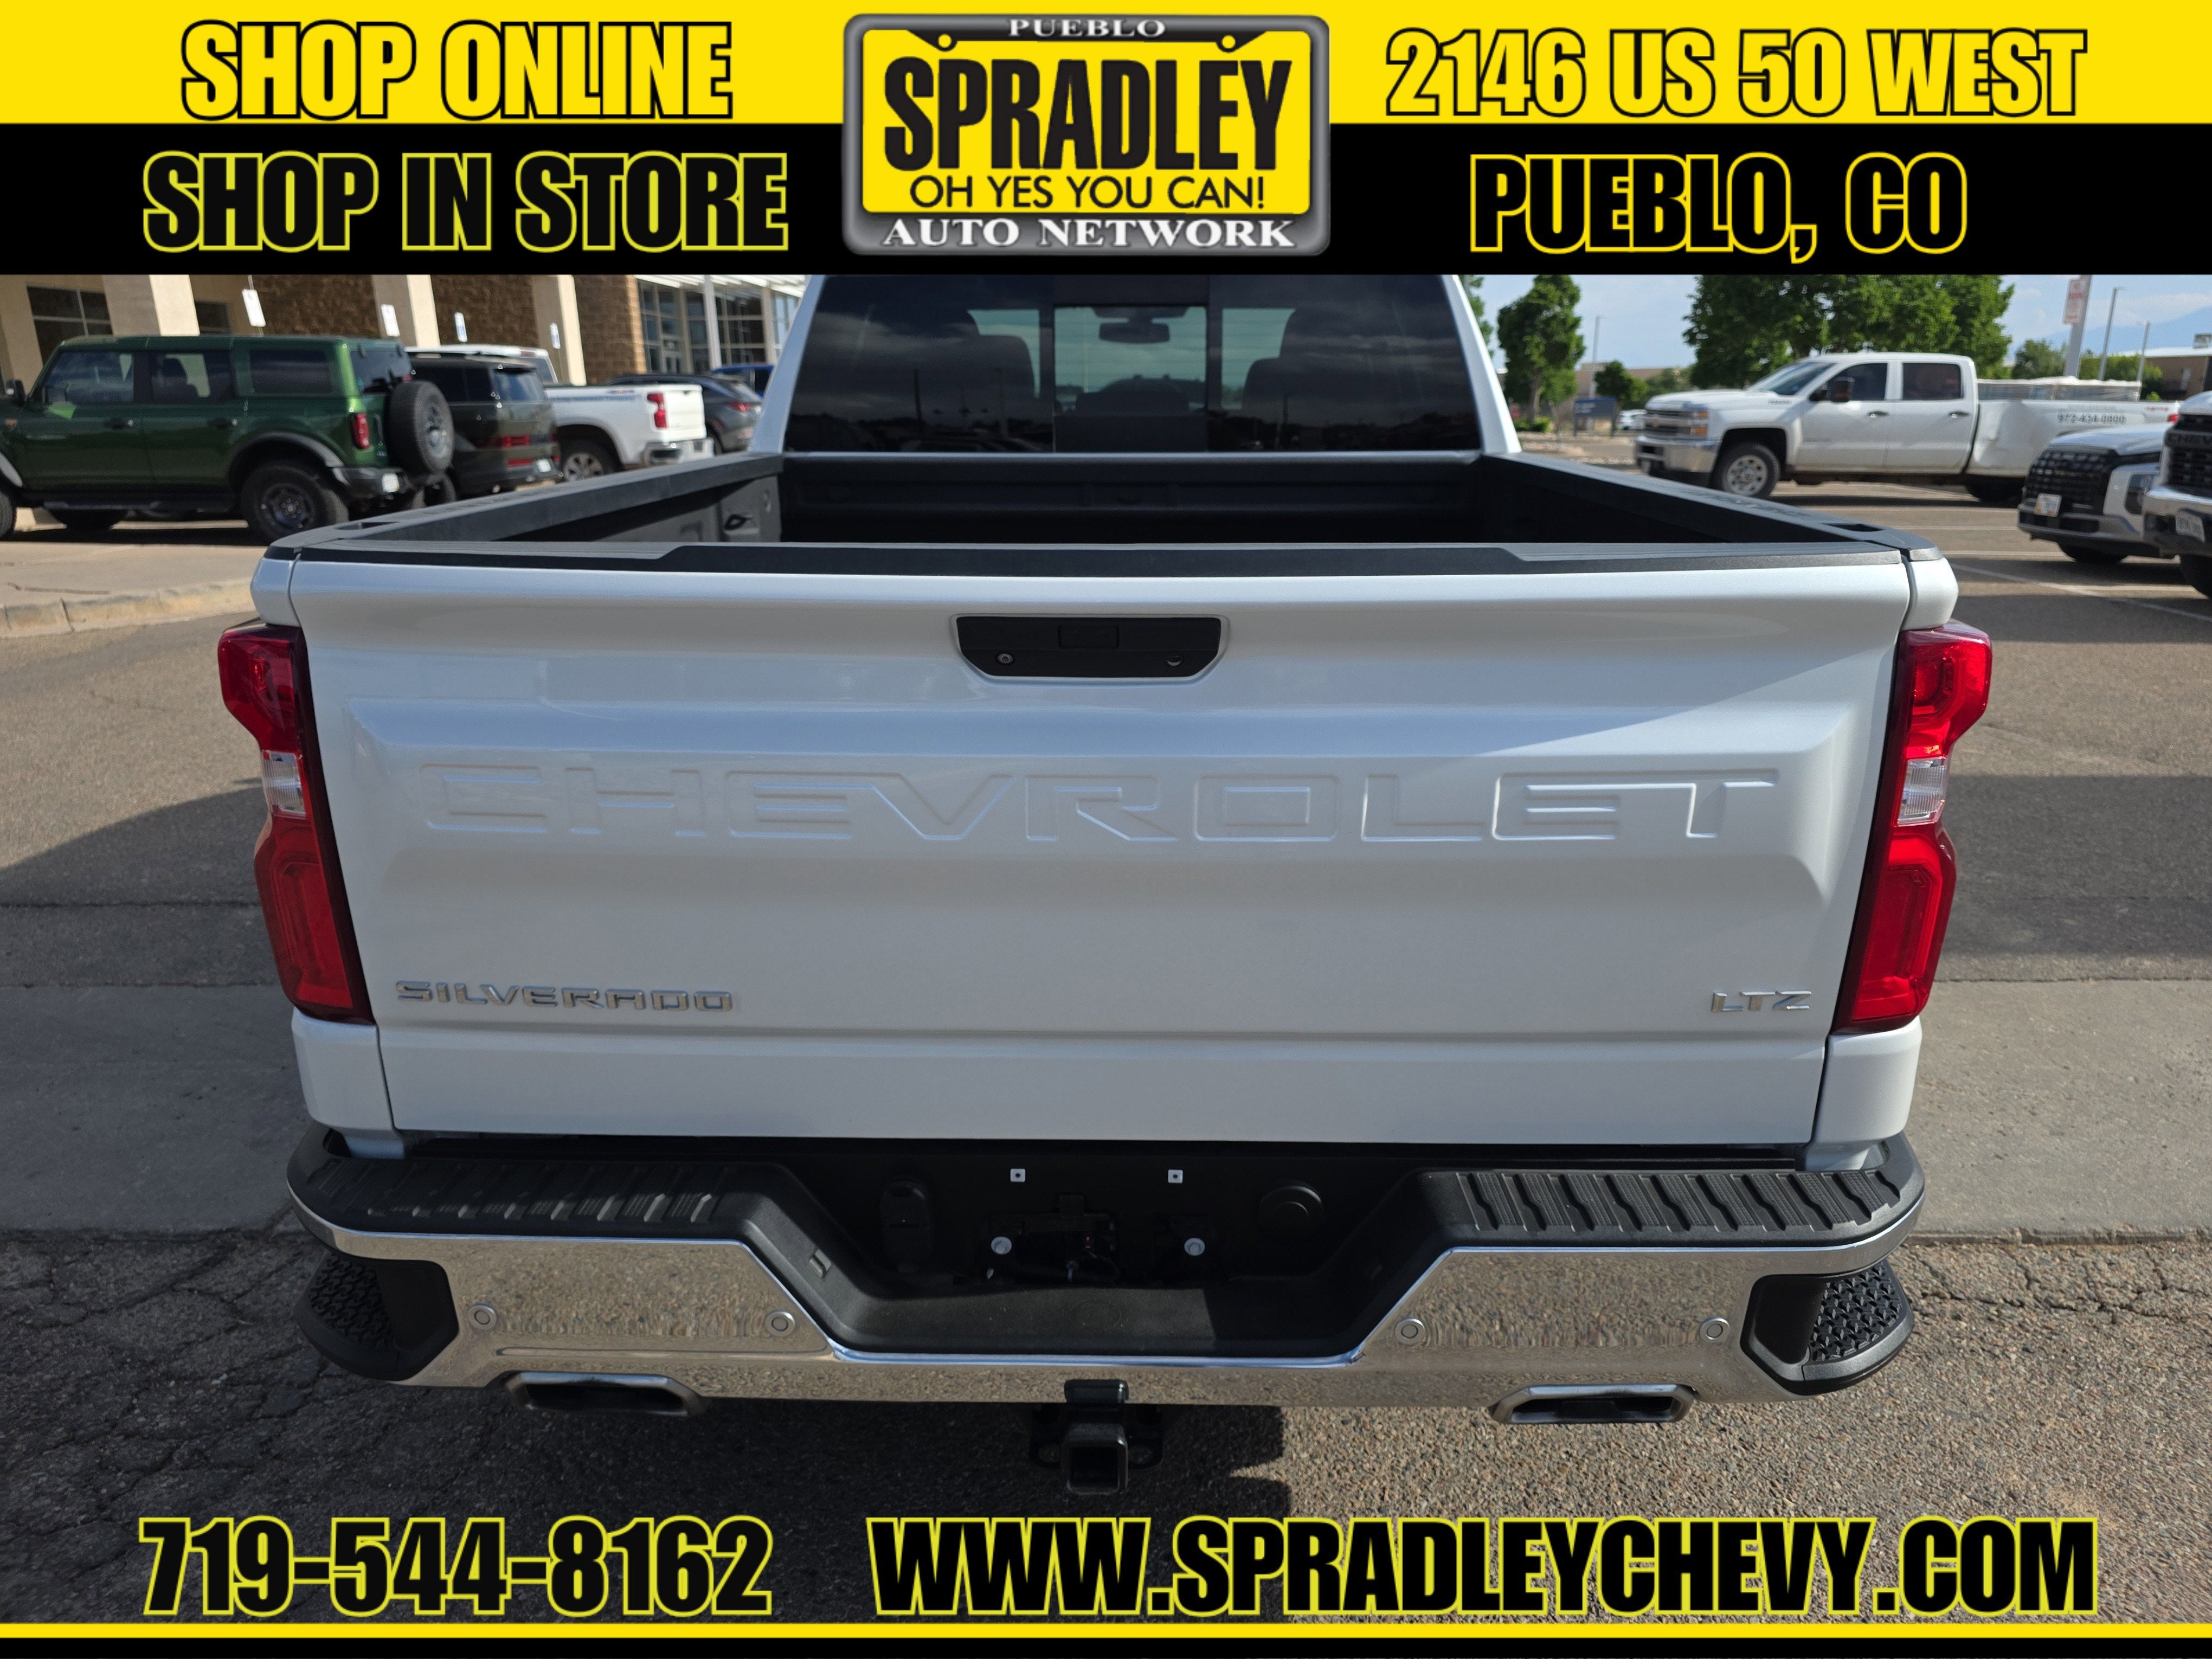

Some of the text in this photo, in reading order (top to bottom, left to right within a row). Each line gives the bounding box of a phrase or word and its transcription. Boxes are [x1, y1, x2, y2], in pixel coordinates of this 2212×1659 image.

[420, 761, 1779, 845] CHEVROLET
[395, 980, 734, 1013] SILVERADO
[1711, 989, 1812, 1013] LTZ
